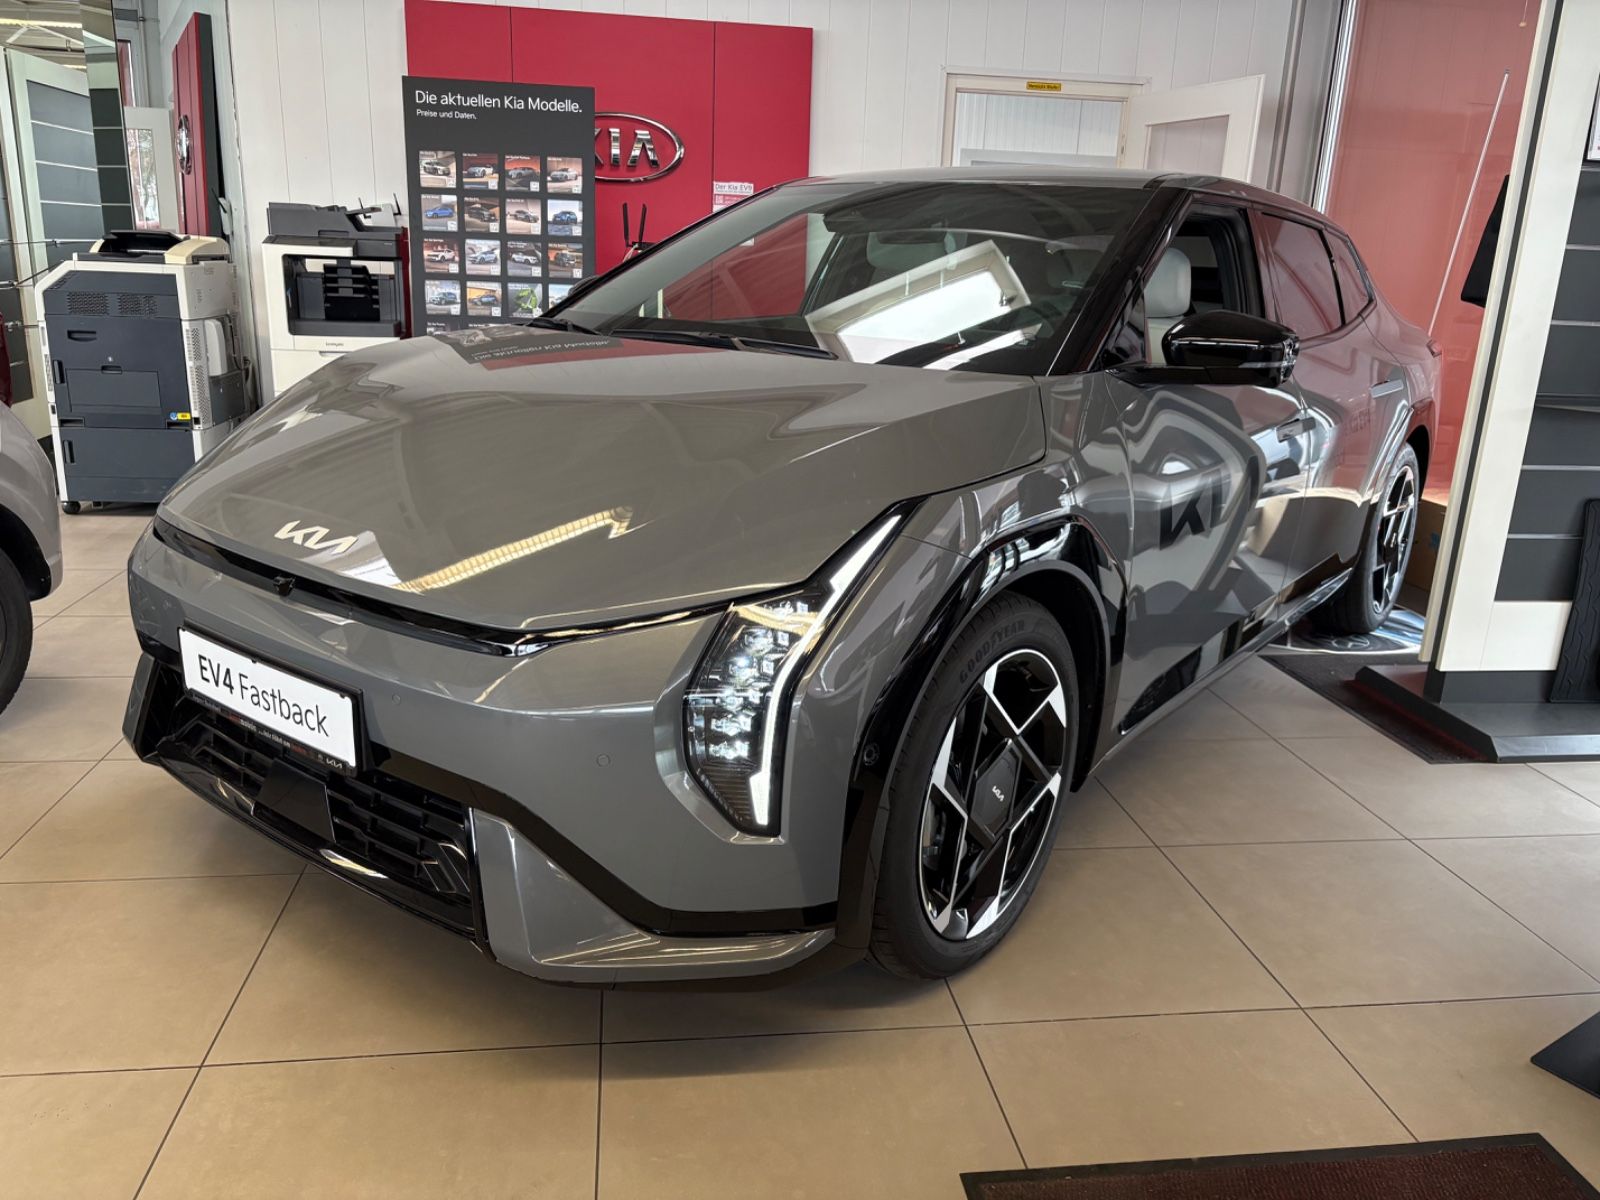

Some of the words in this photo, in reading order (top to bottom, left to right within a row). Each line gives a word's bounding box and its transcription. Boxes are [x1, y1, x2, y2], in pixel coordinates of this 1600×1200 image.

[415, 90, 437, 105] Die
[440, 92, 501, 109] aktuellen
[504, 95, 525, 110] Kia
[528, 97, 583, 113] Modelle.
[416, 109, 438, 118] Preise
[454, 111, 477, 120] Daten.
[595, 127, 660, 167] IA
[959, 619, 1026, 684] GOODYEAR
[198, 653, 235, 695] EV4
[238, 672, 330, 738] Fastback
